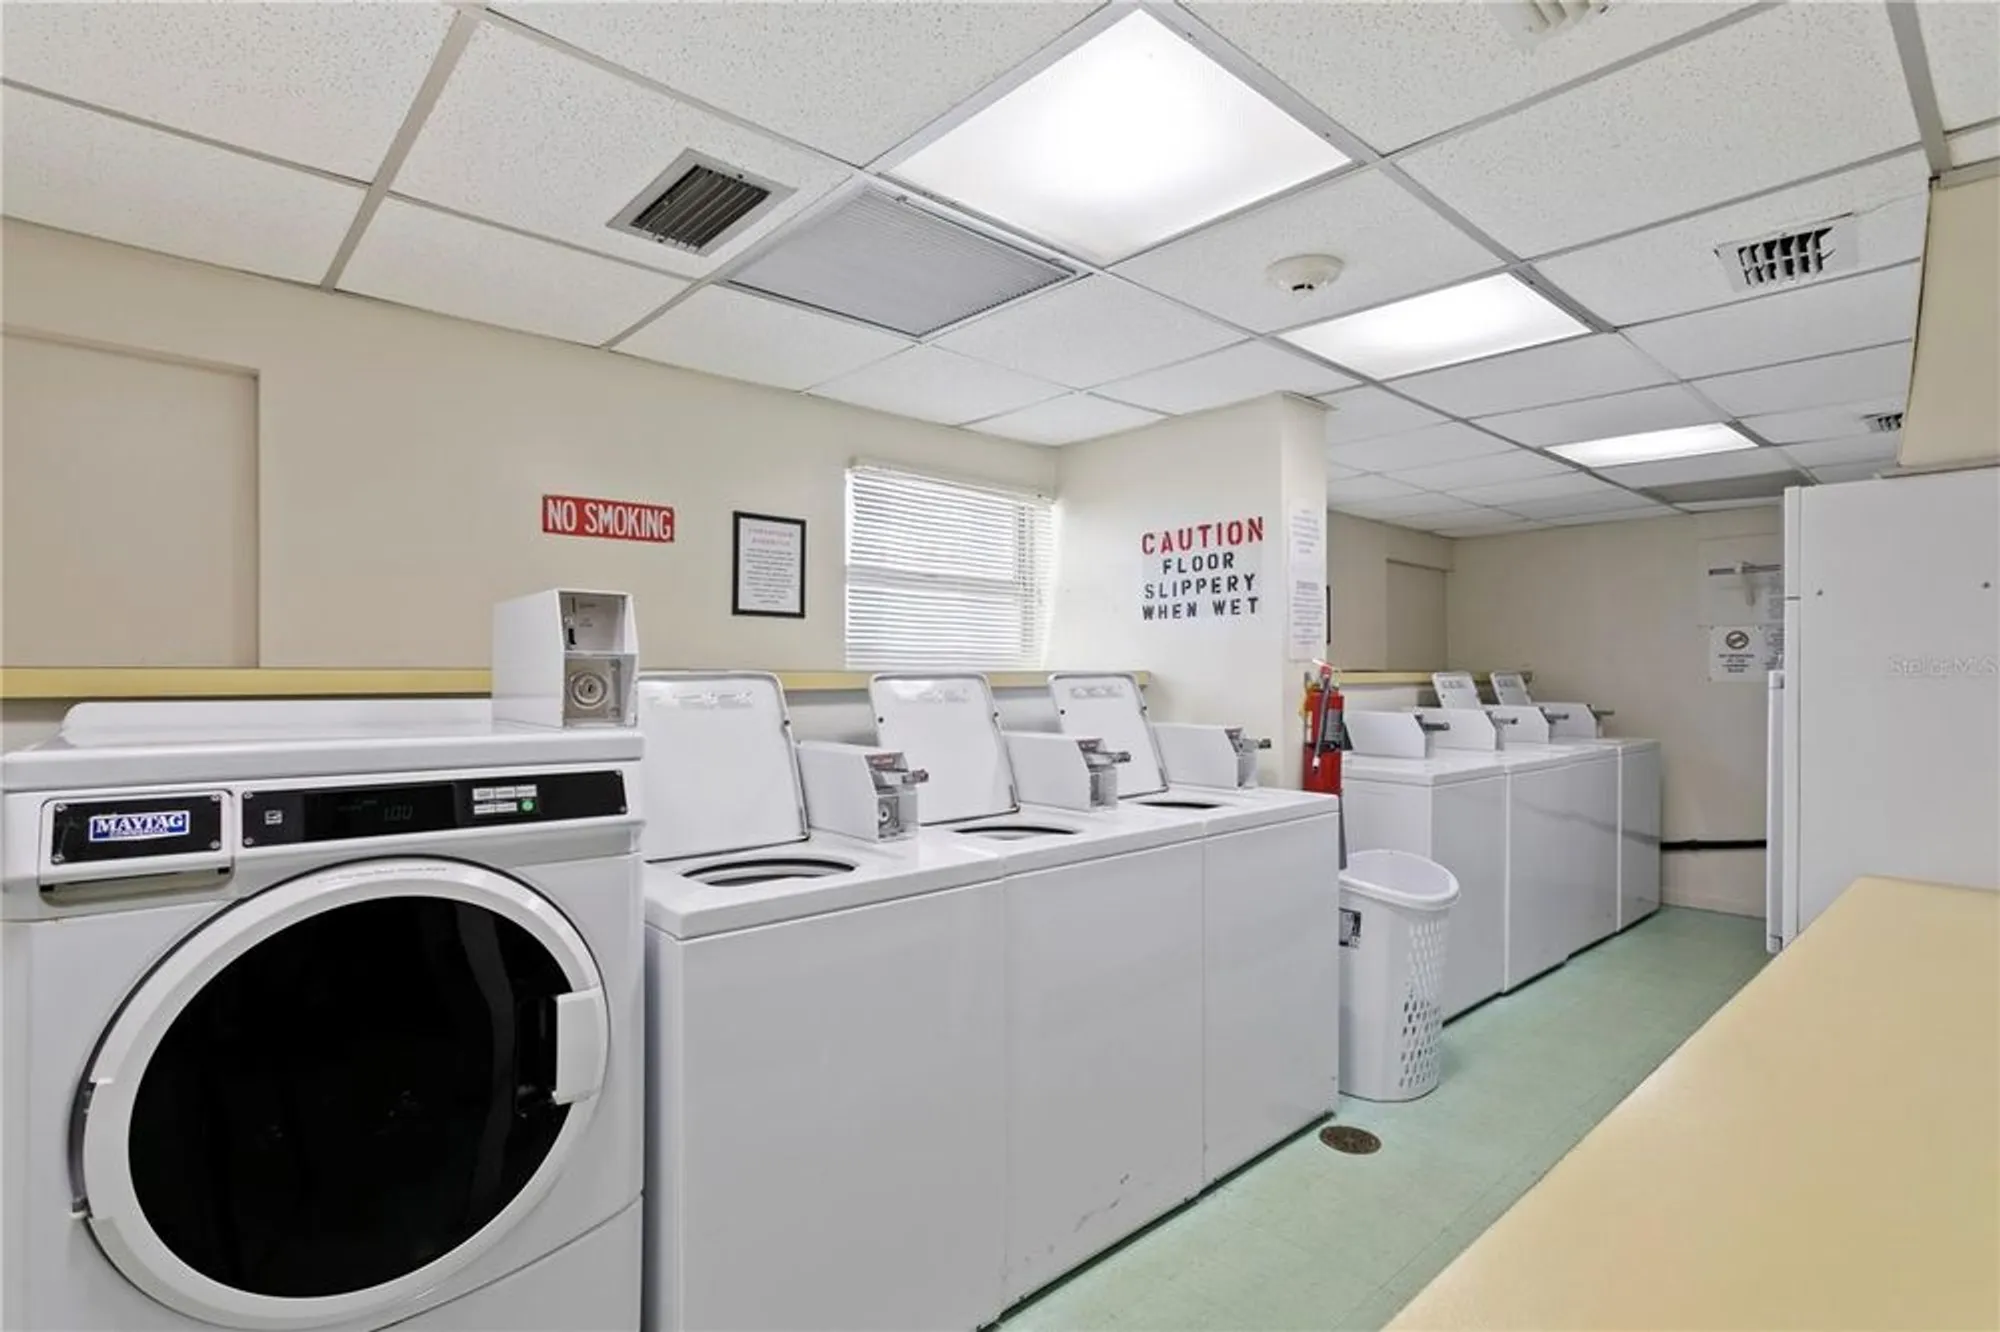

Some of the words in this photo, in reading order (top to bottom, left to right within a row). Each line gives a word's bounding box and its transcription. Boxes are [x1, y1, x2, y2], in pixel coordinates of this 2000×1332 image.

[547, 499, 577, 532] NO
[584, 503, 673, 540] SMOKING
[1141, 516, 1264, 556] CAUTION
[1163, 552, 1235, 575] FLOOR
[1145, 573, 1256, 600] SLIPPERY
[1142, 602, 1198, 621] WHEN
[1212, 597, 1259, 616] WET
[95, 815, 184, 834] MAYTAG
